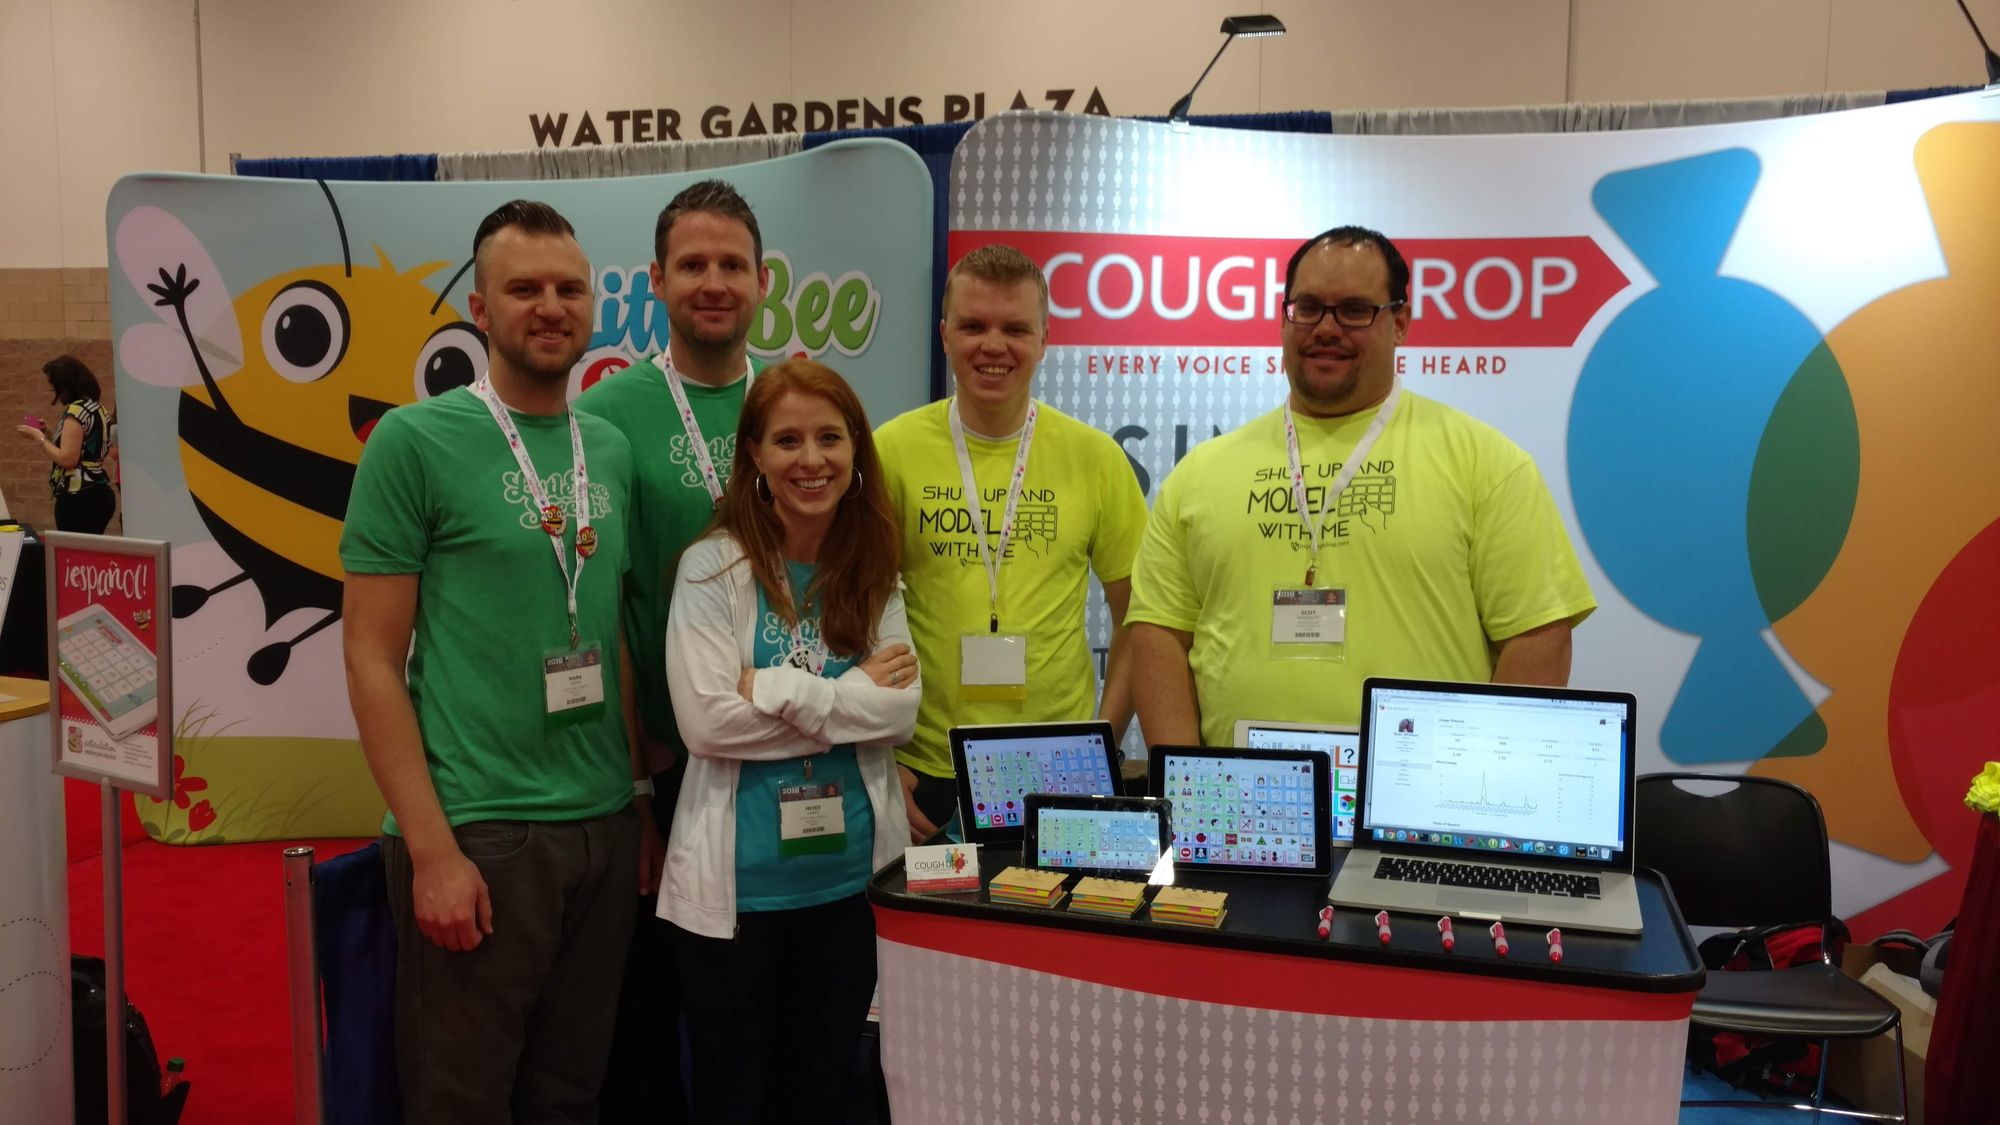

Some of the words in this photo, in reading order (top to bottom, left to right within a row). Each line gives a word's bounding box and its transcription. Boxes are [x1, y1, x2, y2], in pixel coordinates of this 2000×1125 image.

[529, 108, 682, 148] WATER
[701, 96, 924, 138] GARDENS
[1042, 252, 1285, 320] COUGH
[1411, 256, 1578, 320] ROP
[749, 257, 876, 350] Bee
[1088, 356, 1161, 374] EVERY
[1177, 356, 1250, 374] VOICE
[1422, 356, 1507, 374] HEARD
[1318, 462, 1342, 478] UP
[923, 486, 965, 501] SHU
[984, 488, 1007, 502] UP
[1258, 523, 1311, 540] WITH
[1321, 520, 1349, 539] ME
[930, 542, 979, 558] WITH
[915, 860, 944, 870] COUGH
